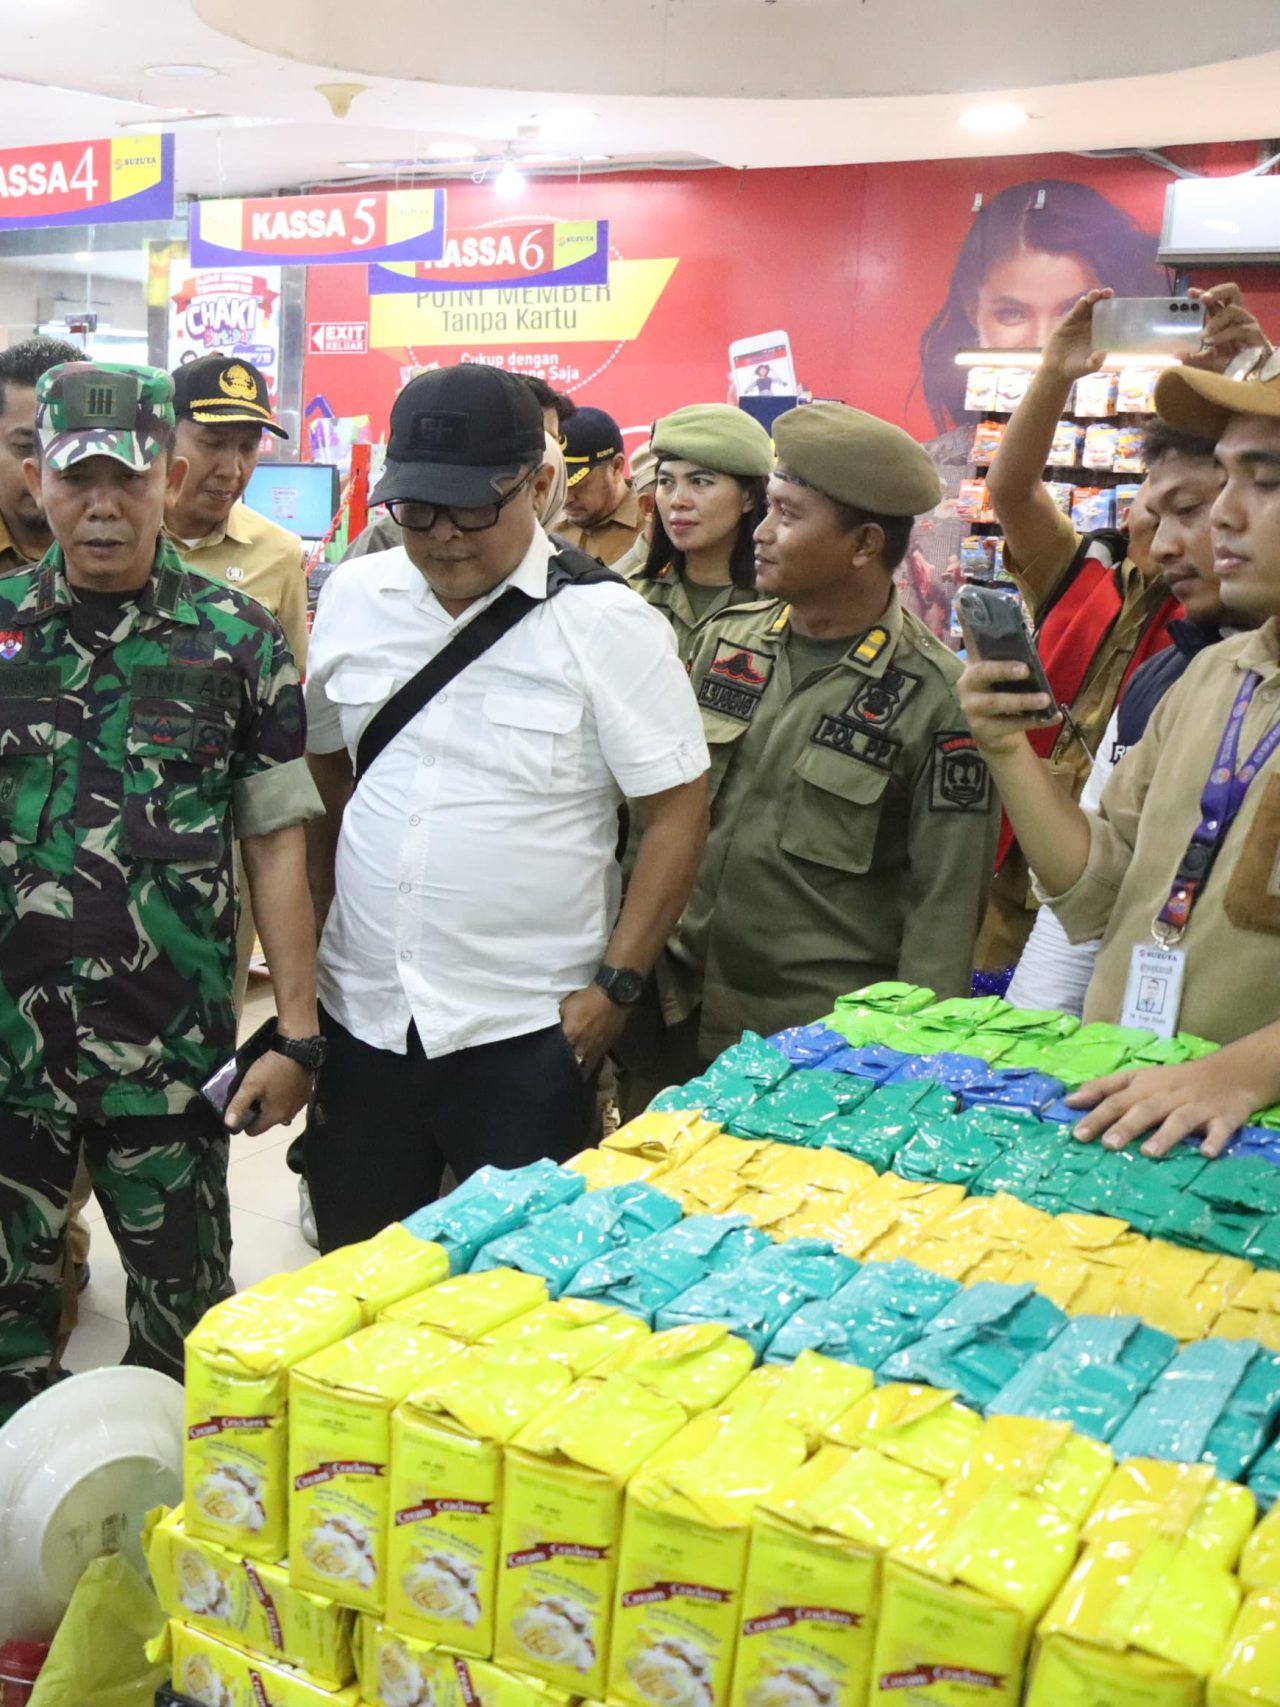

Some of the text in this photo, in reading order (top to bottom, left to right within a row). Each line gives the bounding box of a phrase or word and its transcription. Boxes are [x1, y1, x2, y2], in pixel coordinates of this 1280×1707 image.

[70, 146, 98, 201] 4
[252, 198, 376, 245] KASSA 5
[425, 228, 544, 270] ASSA 6
[497, 283, 611, 306] MEMBER
[186, 296, 257, 339] CHAKI
[442, 306, 577, 334] Tanpa Kartu
[326, 325, 365, 340] EXIT
[326, 341, 363, 351] KELUAR
[461, 351, 558, 369] Cukup dengan
[550, 366, 579, 384] Saja
[821, 721, 892, 761] POL PP
